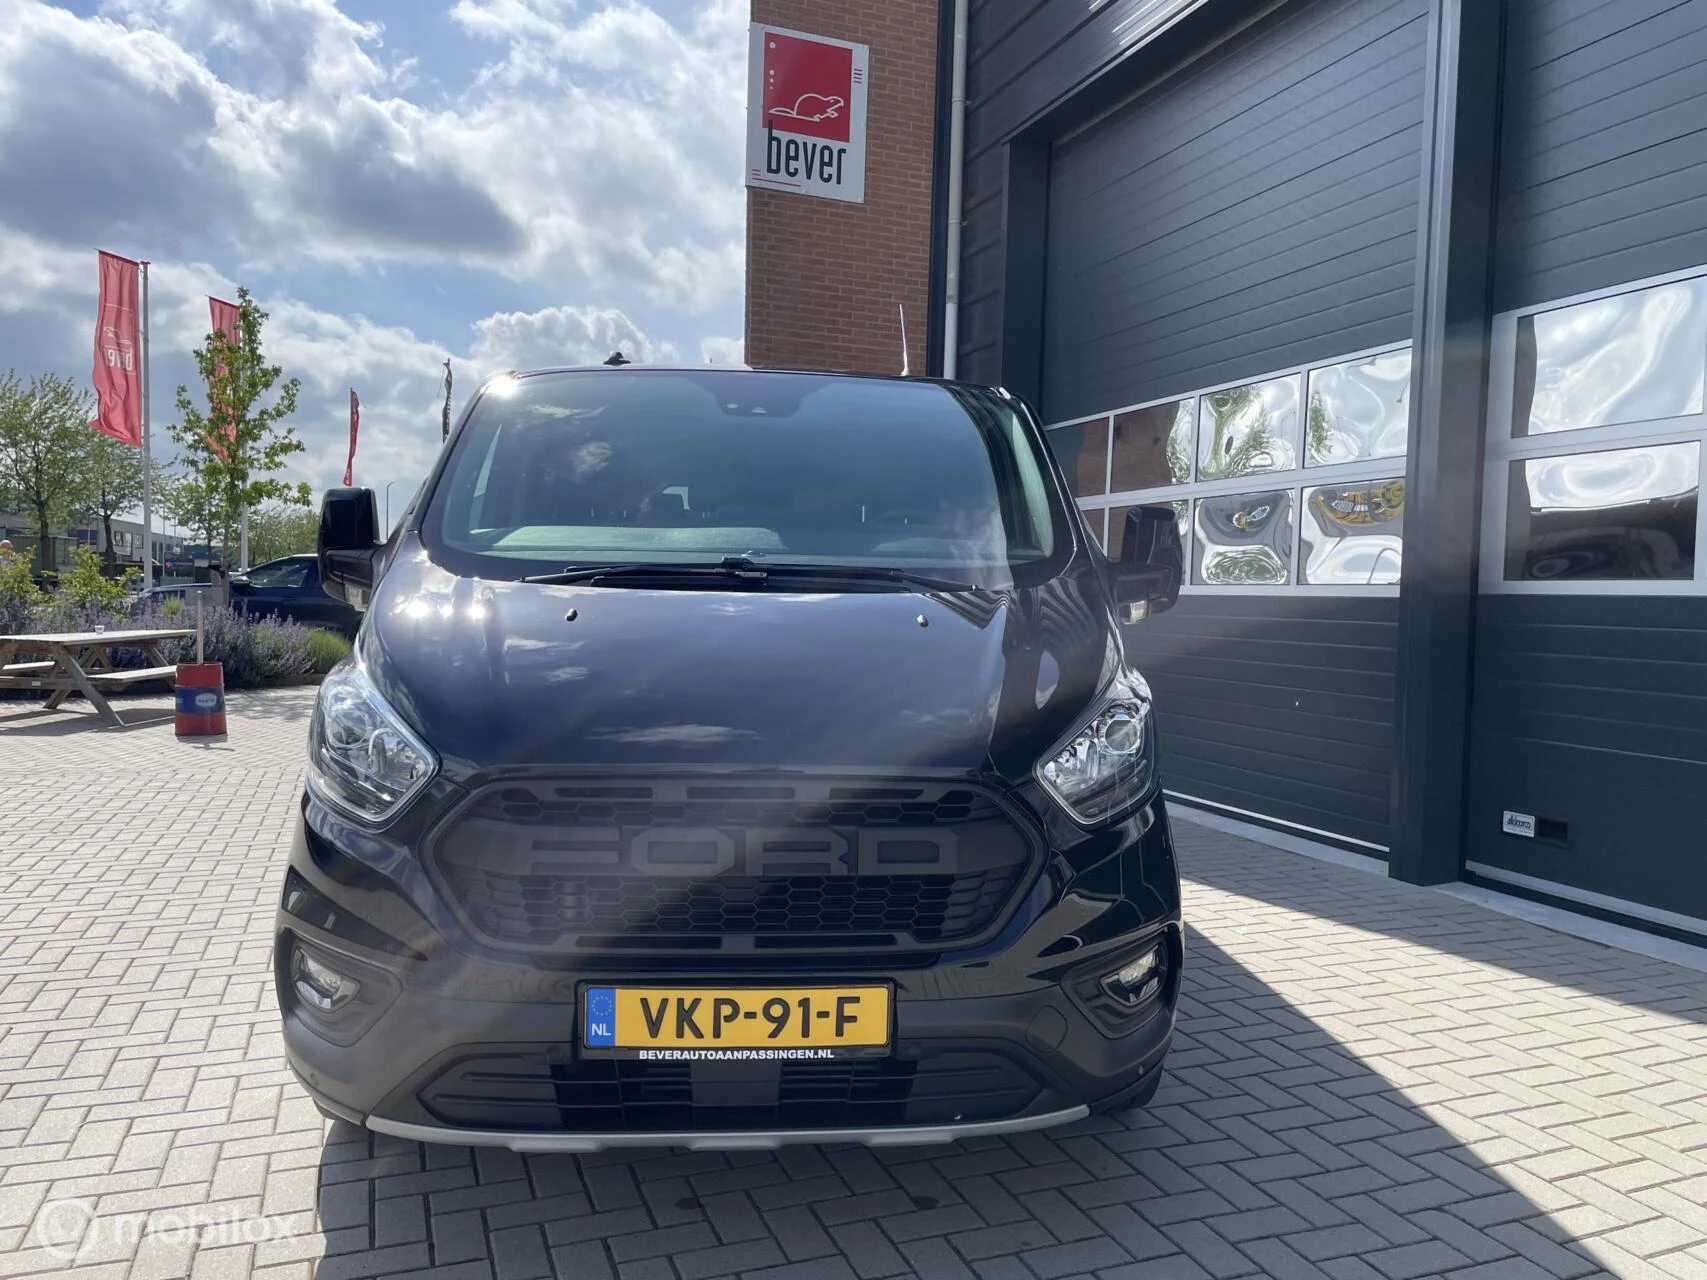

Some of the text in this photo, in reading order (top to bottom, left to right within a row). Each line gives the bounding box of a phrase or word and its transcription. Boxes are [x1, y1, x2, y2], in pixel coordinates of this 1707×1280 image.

[766, 119, 847, 185] bever
[514, 826, 958, 876] FORD
[591, 1023, 611, 1036] NL
[639, 996, 861, 1039] VKP-91-F
[638, 1049, 835, 1060] BEVERAUTOAANPASSINGEN.NL
